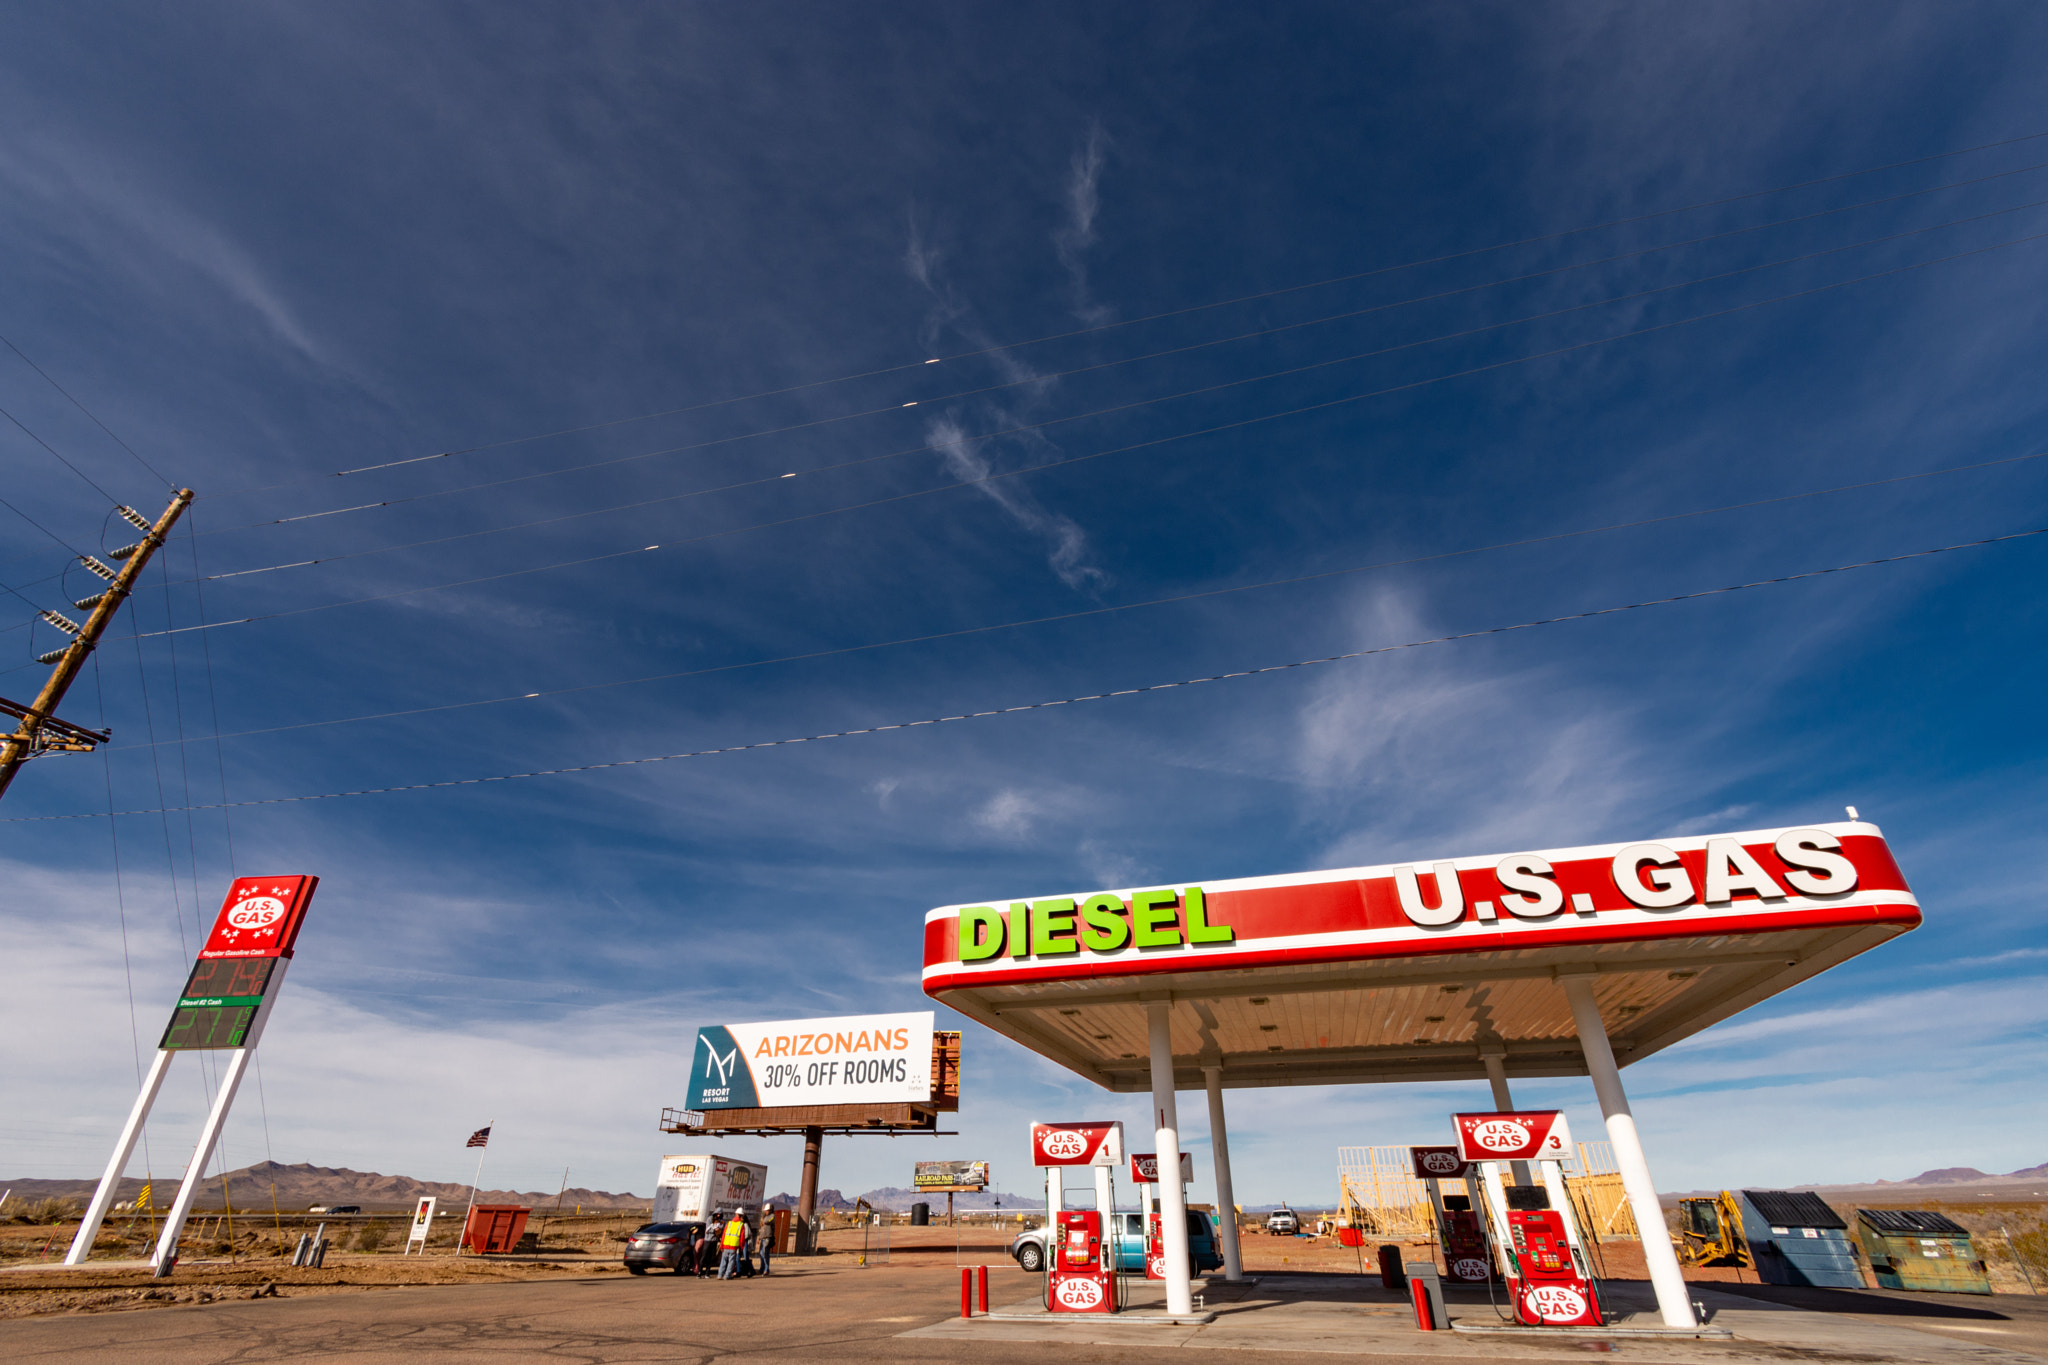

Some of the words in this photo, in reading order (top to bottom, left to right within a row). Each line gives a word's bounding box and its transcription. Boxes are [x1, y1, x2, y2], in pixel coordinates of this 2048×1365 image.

[1393, 853, 1597, 927] U.S.
[1611, 828, 1859, 909] GAS
[244, 900, 274, 911] U.S.
[233, 911, 274, 924] GAS
[958, 886, 1235, 962] DIESEL
[203, 950, 225, 958] Regular
[187, 958, 262, 997] 2.79
[754, 1028, 909, 1058] ARIZONANS
[764, 1064, 800, 1089] 30%
[807, 1061, 839, 1086] OFF
[843, 1058, 907, 1085] ROOMS
[703, 1087, 730, 1097] RESORT
[1485, 1124, 1518, 1134] U.S.
[1053, 1134, 1078, 1143] U.S.
[1482, 1135, 1523, 1148] GAS
[1549, 1135, 1562, 1149] 3
[1048, 1144, 1081, 1155] GAS
[1102, 1143, 1109, 1156] 1
[677, 1165, 695, 1173] HUB
[1142, 1167, 1158, 1175] GA
[1428, 1162, 1455, 1170] GAS
[733, 1170, 749, 1186] HUB
[726, 1183, 742, 1199] Has
[1461, 1260, 1483, 1268] U.S.
[1459, 1269, 1486, 1277] GAS
[1067, 1281, 1093, 1291] U.S.
[1062, 1292, 1097, 1304] GAS
[1539, 1290, 1573, 1302] U.S.
[1535, 1303, 1580, 1316] GAS
